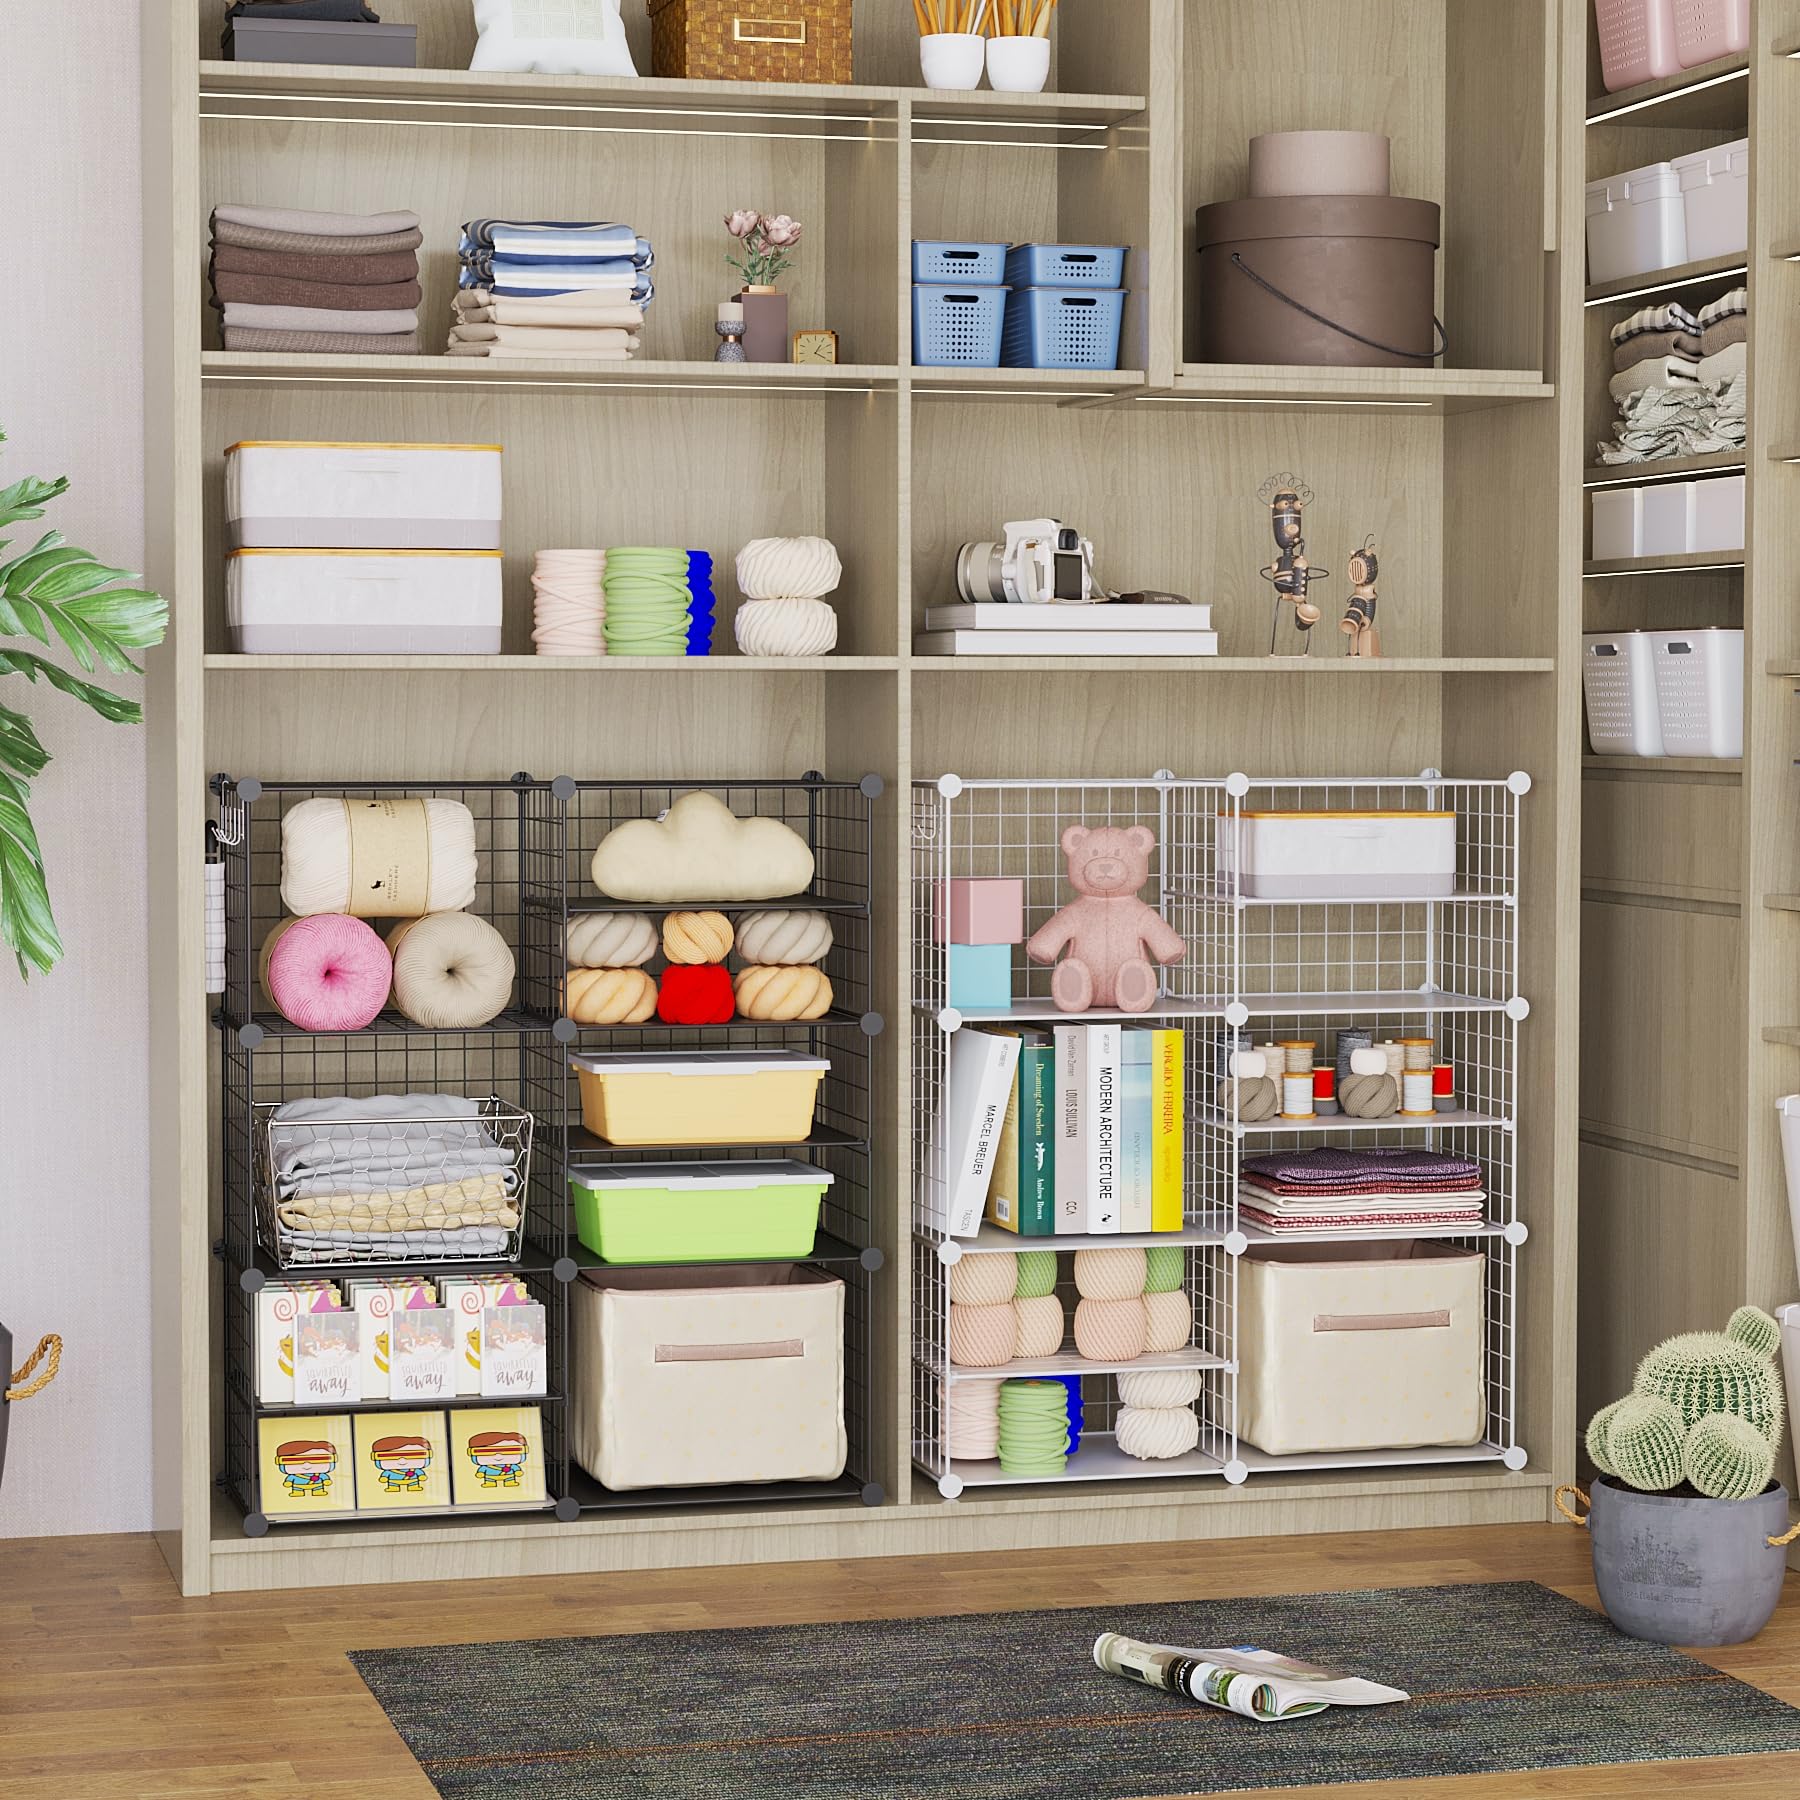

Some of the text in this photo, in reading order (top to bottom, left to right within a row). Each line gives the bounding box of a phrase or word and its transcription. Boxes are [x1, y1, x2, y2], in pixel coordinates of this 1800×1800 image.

[1033, 1063, 1045, 1136] Dreaming of Sweden
[1066, 1089, 1078, 1138] LOUIS SULLIVAN
[1163, 1091, 1173, 1135] FERREIRA
[972, 1104, 997, 1176] MARCEL BREUER
[1099, 1067, 1113, 1199] MODERN ARCHITECTURE
[1036, 1177, 1045, 1220] Andrew Brown
[309, 1377, 351, 1397] away
[404, 1371, 447, 1393] away
[496, 1368, 537, 1390] away
